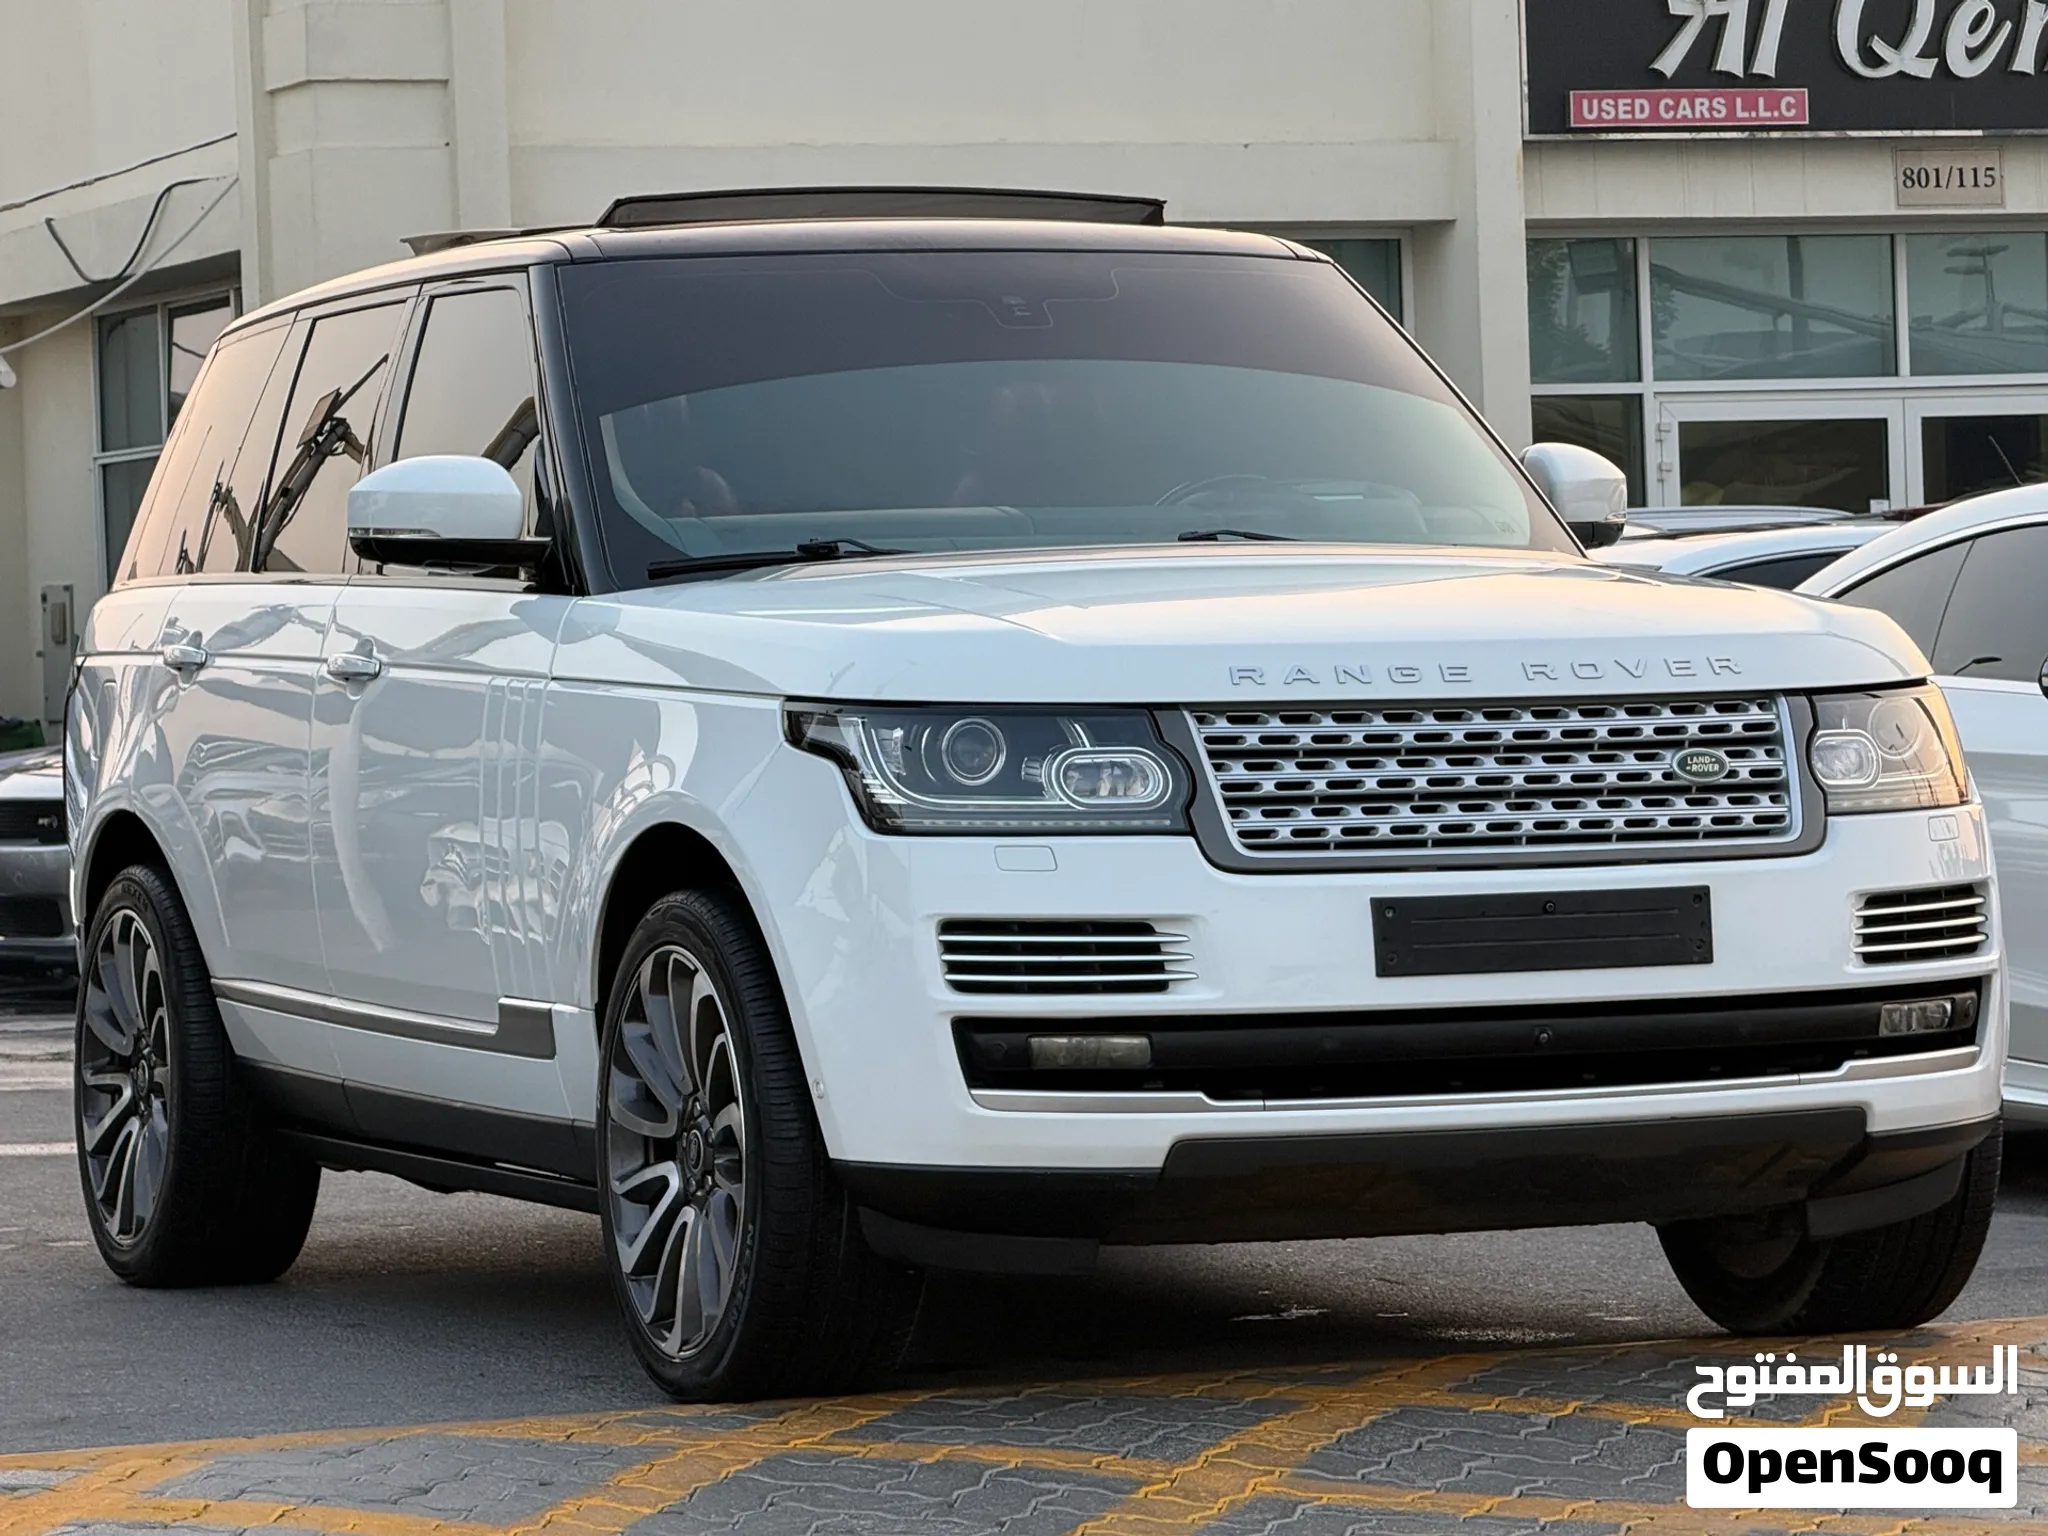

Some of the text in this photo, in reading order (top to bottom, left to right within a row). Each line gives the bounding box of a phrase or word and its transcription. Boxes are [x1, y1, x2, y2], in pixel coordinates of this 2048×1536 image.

[1581, 95, 1797, 120] USED CARS L.L.C
[1901, 165, 1997, 190] 801/115
[1229, 655, 1744, 686] RANGE ROVER
[1687, 756, 1711, 765] LAND
[1691, 763, 1720, 773] ROVER
